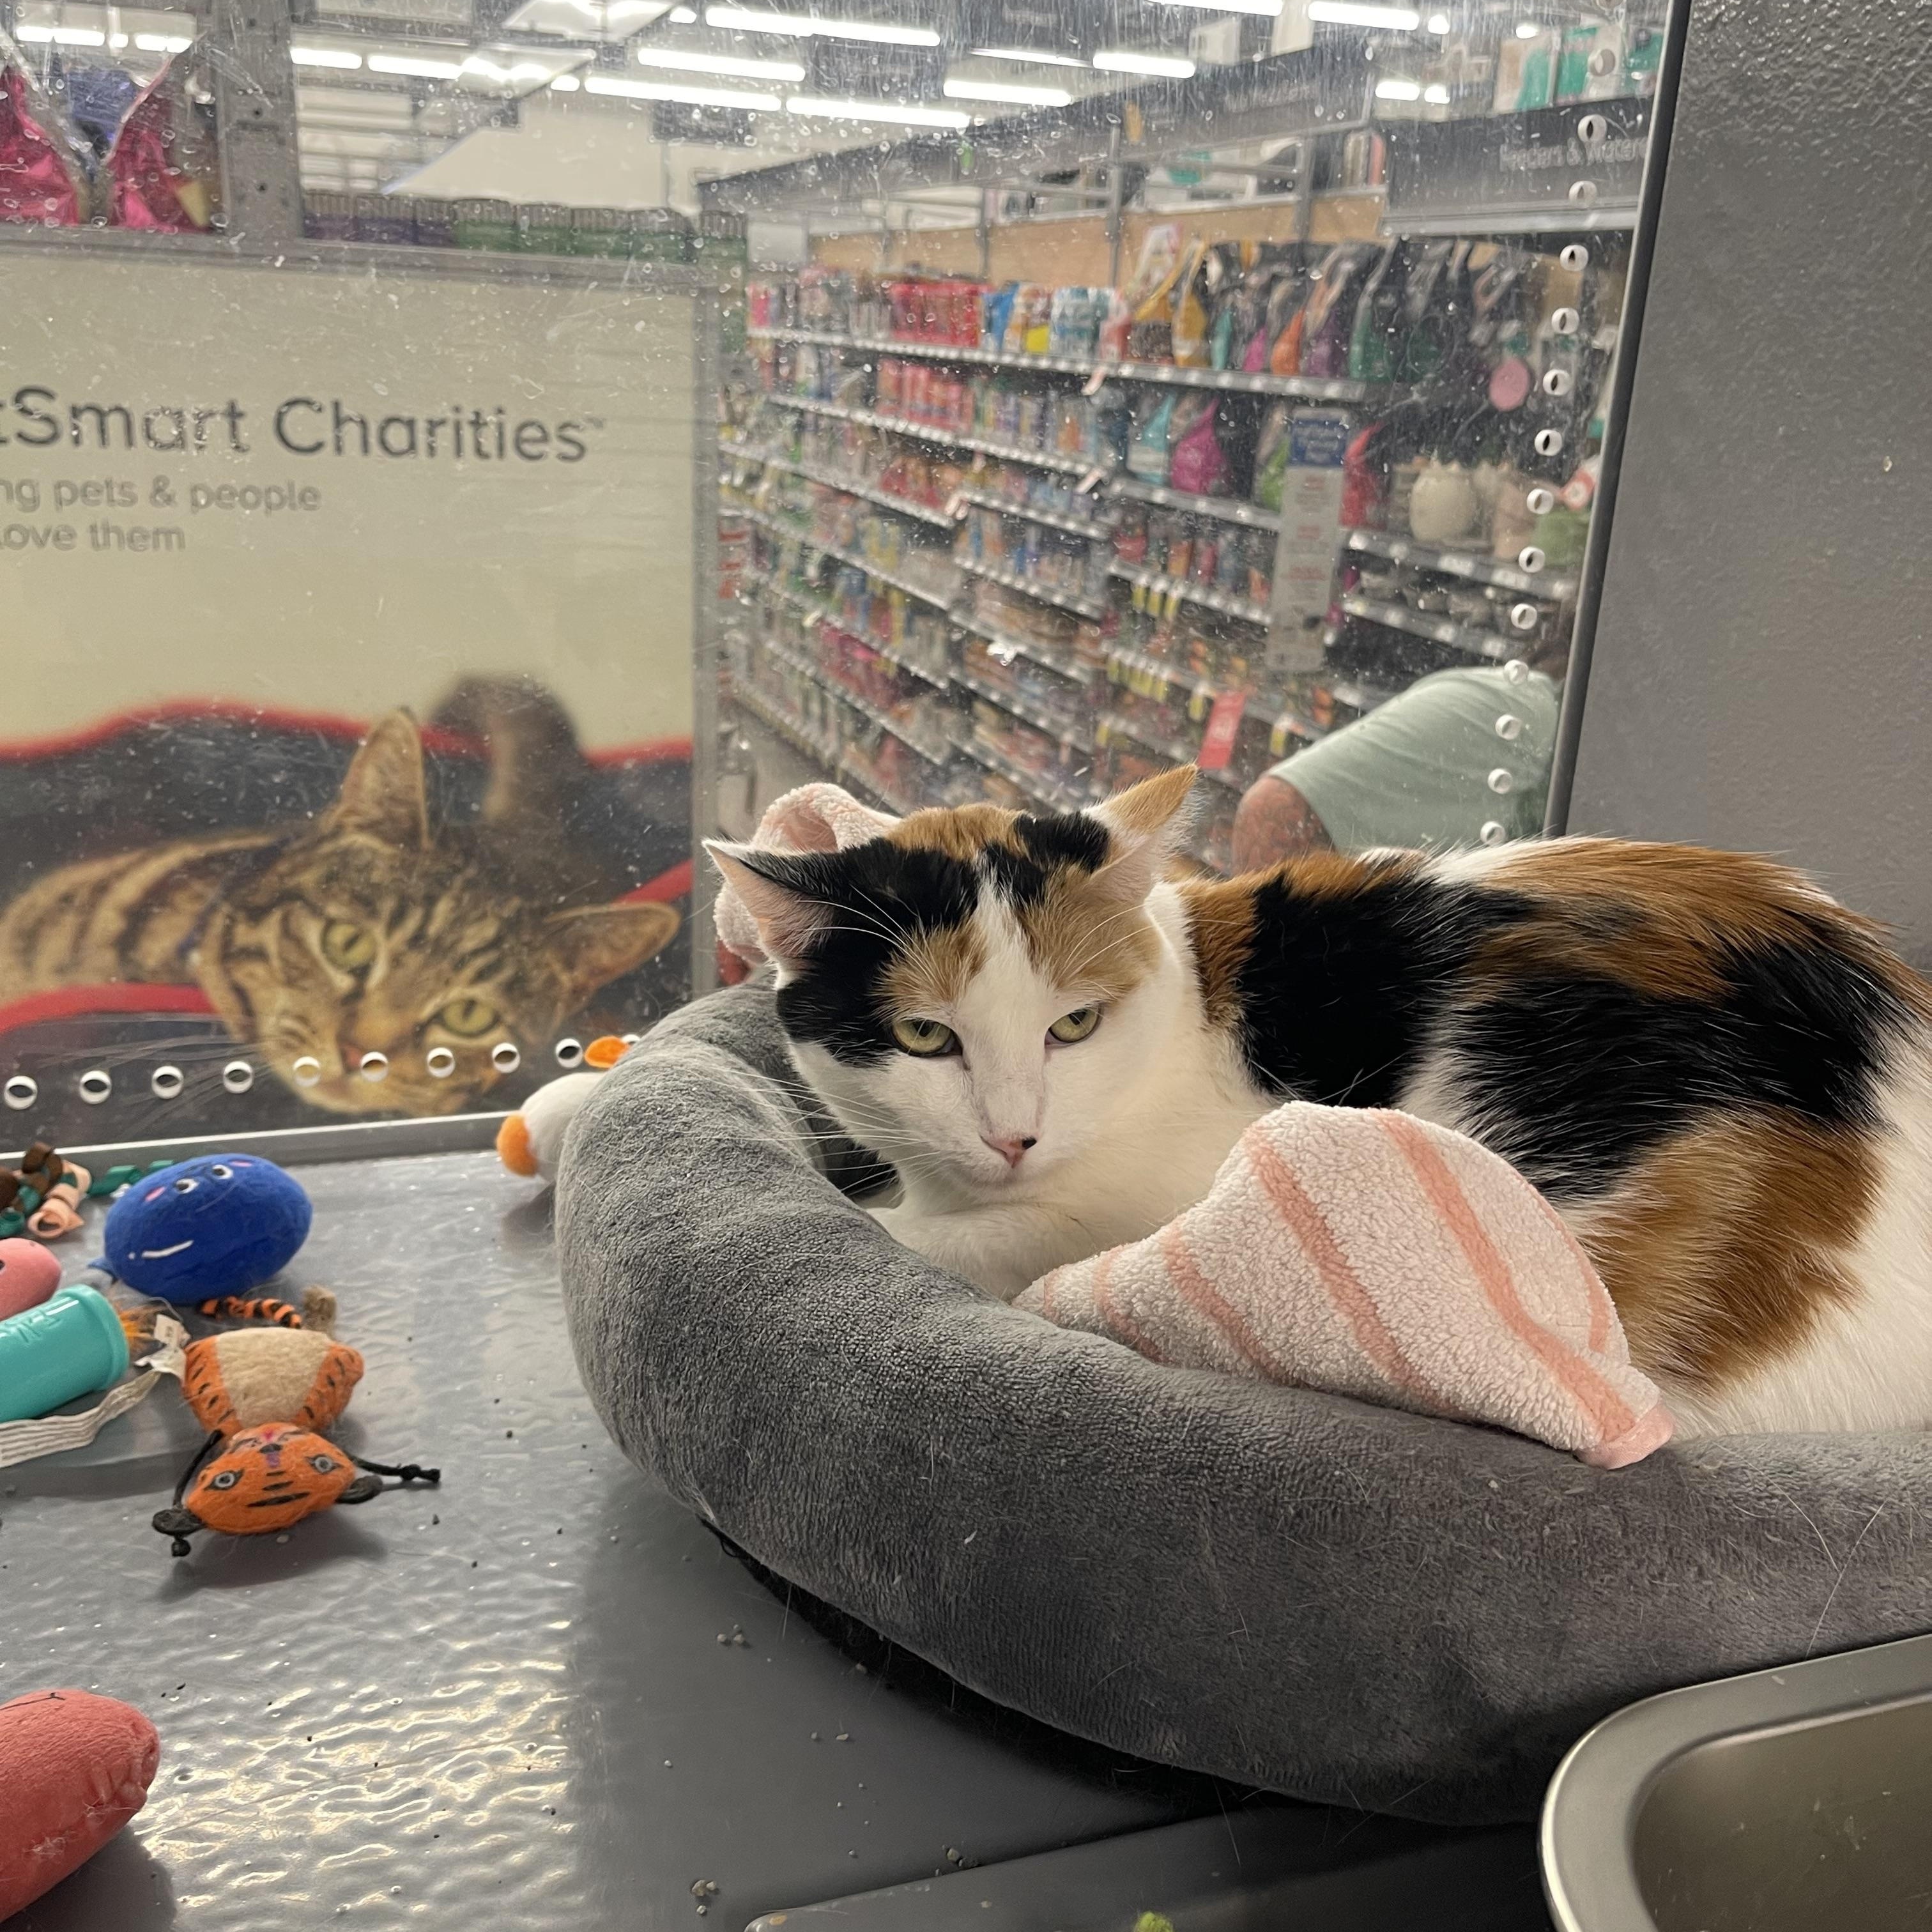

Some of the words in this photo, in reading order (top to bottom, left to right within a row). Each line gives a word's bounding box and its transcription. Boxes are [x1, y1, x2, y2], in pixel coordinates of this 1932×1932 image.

[1567, 137, 1584, 166] &
[54, 477, 139, 512] pets
[150, 474, 176, 509] &
[190, 480, 322, 515] people
[0, 522, 77, 551] ove
[89, 518, 186, 552] them
